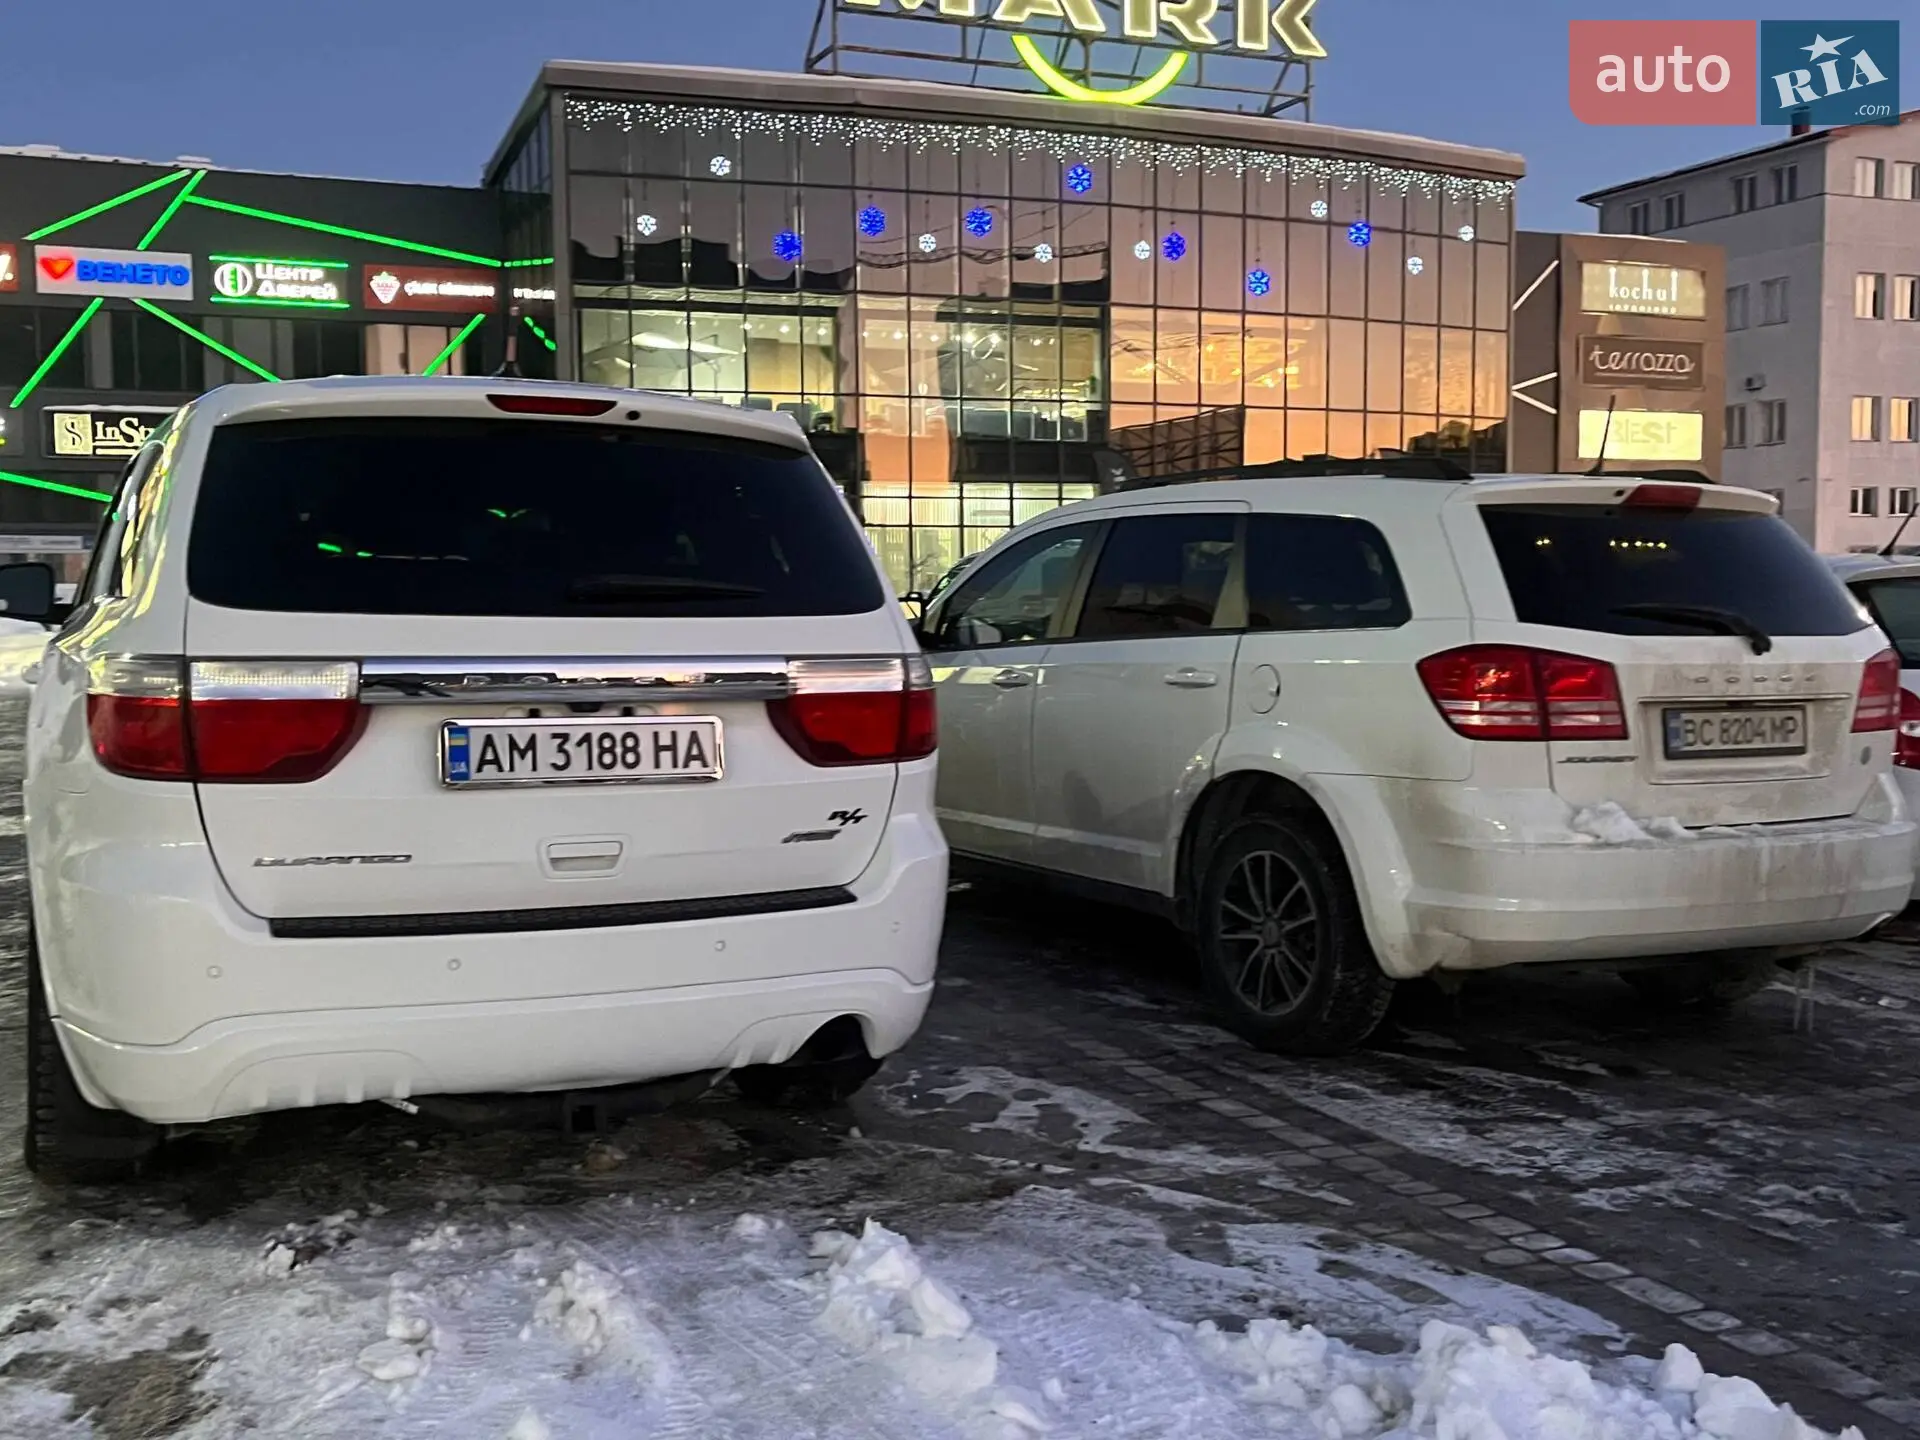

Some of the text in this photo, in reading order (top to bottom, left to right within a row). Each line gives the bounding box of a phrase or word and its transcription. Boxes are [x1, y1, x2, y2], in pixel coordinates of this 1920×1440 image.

[845, 0, 1328, 58] ARK
[76, 259, 191, 287] ВЕНЕТО
[1682, 718, 1714, 746] BC
[1719, 716, 1767, 745] 8204
[475, 730, 709, 773] AM 3188 HA
